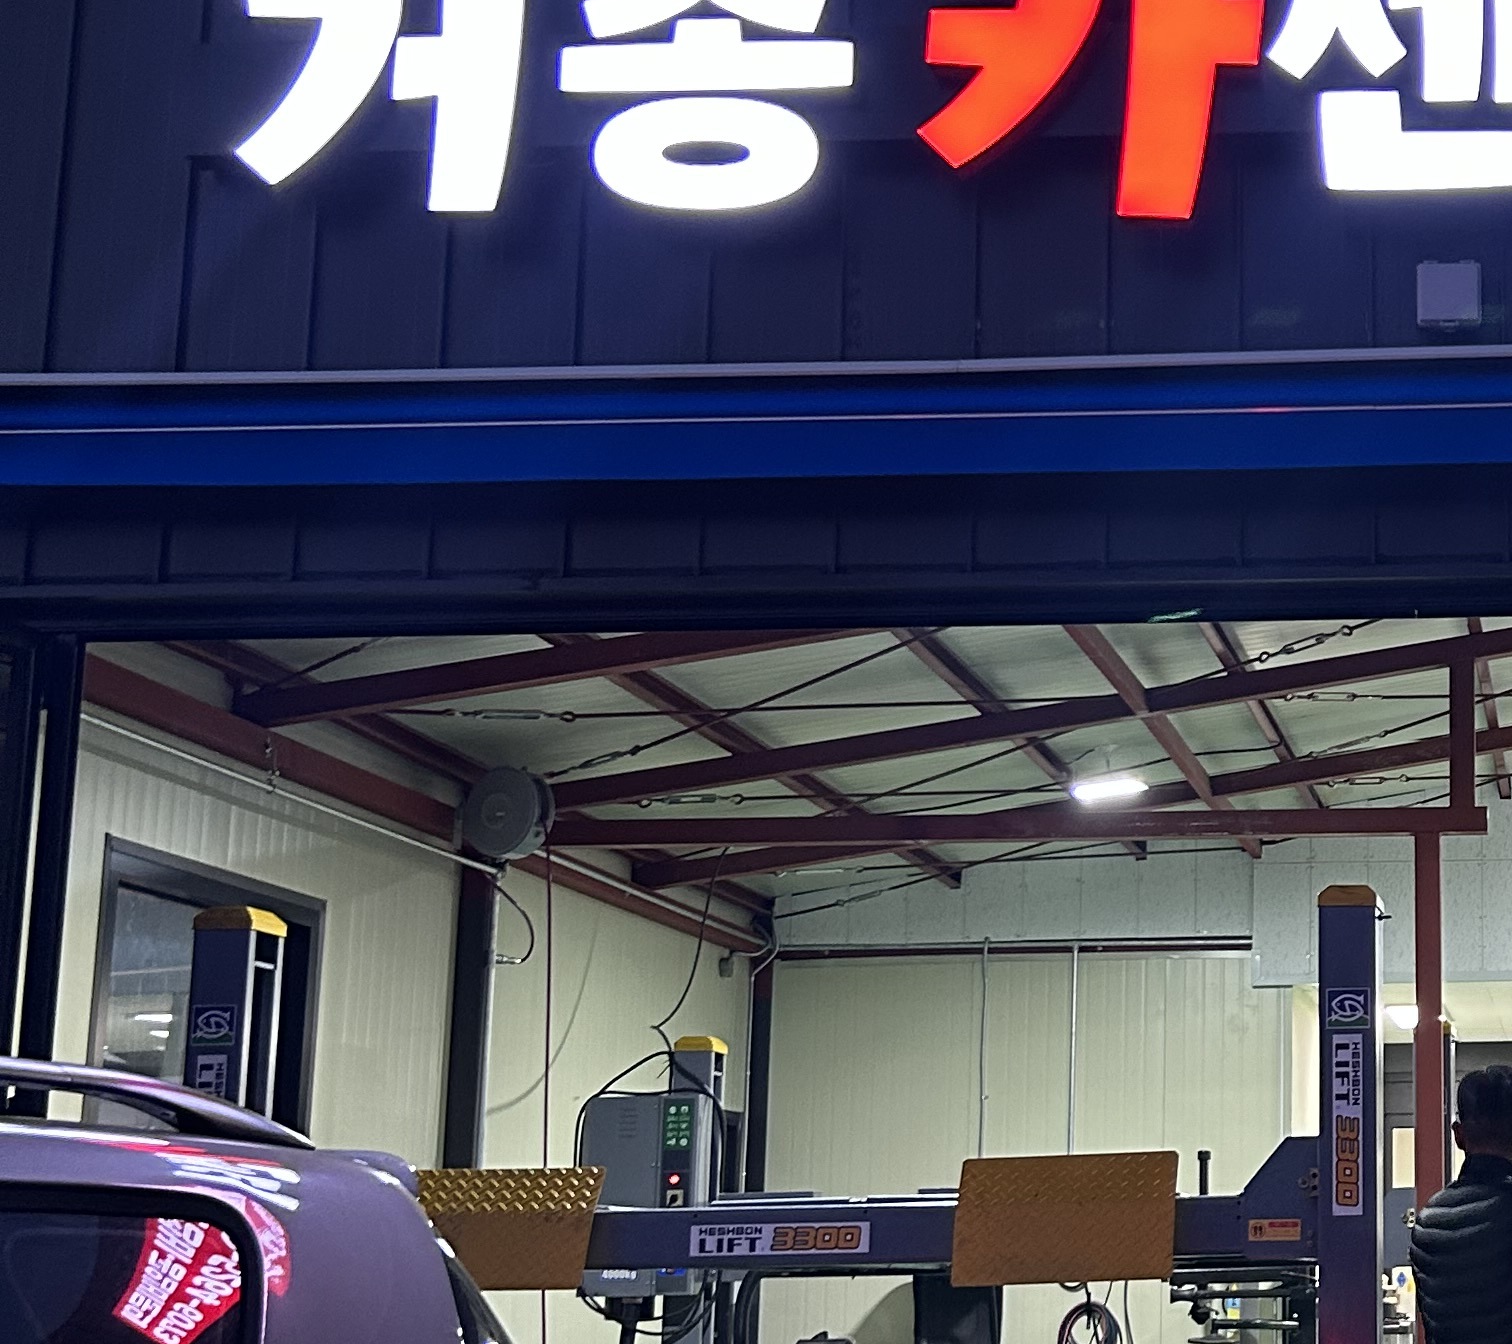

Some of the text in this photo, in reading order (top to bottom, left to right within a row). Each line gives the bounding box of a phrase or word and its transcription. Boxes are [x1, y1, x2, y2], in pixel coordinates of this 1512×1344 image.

[1334, 1042, 1360, 1207] LIFT 3300
[698, 1226, 763, 1237] HESHBON
[698, 1225, 862, 1254] LIFT 3300
